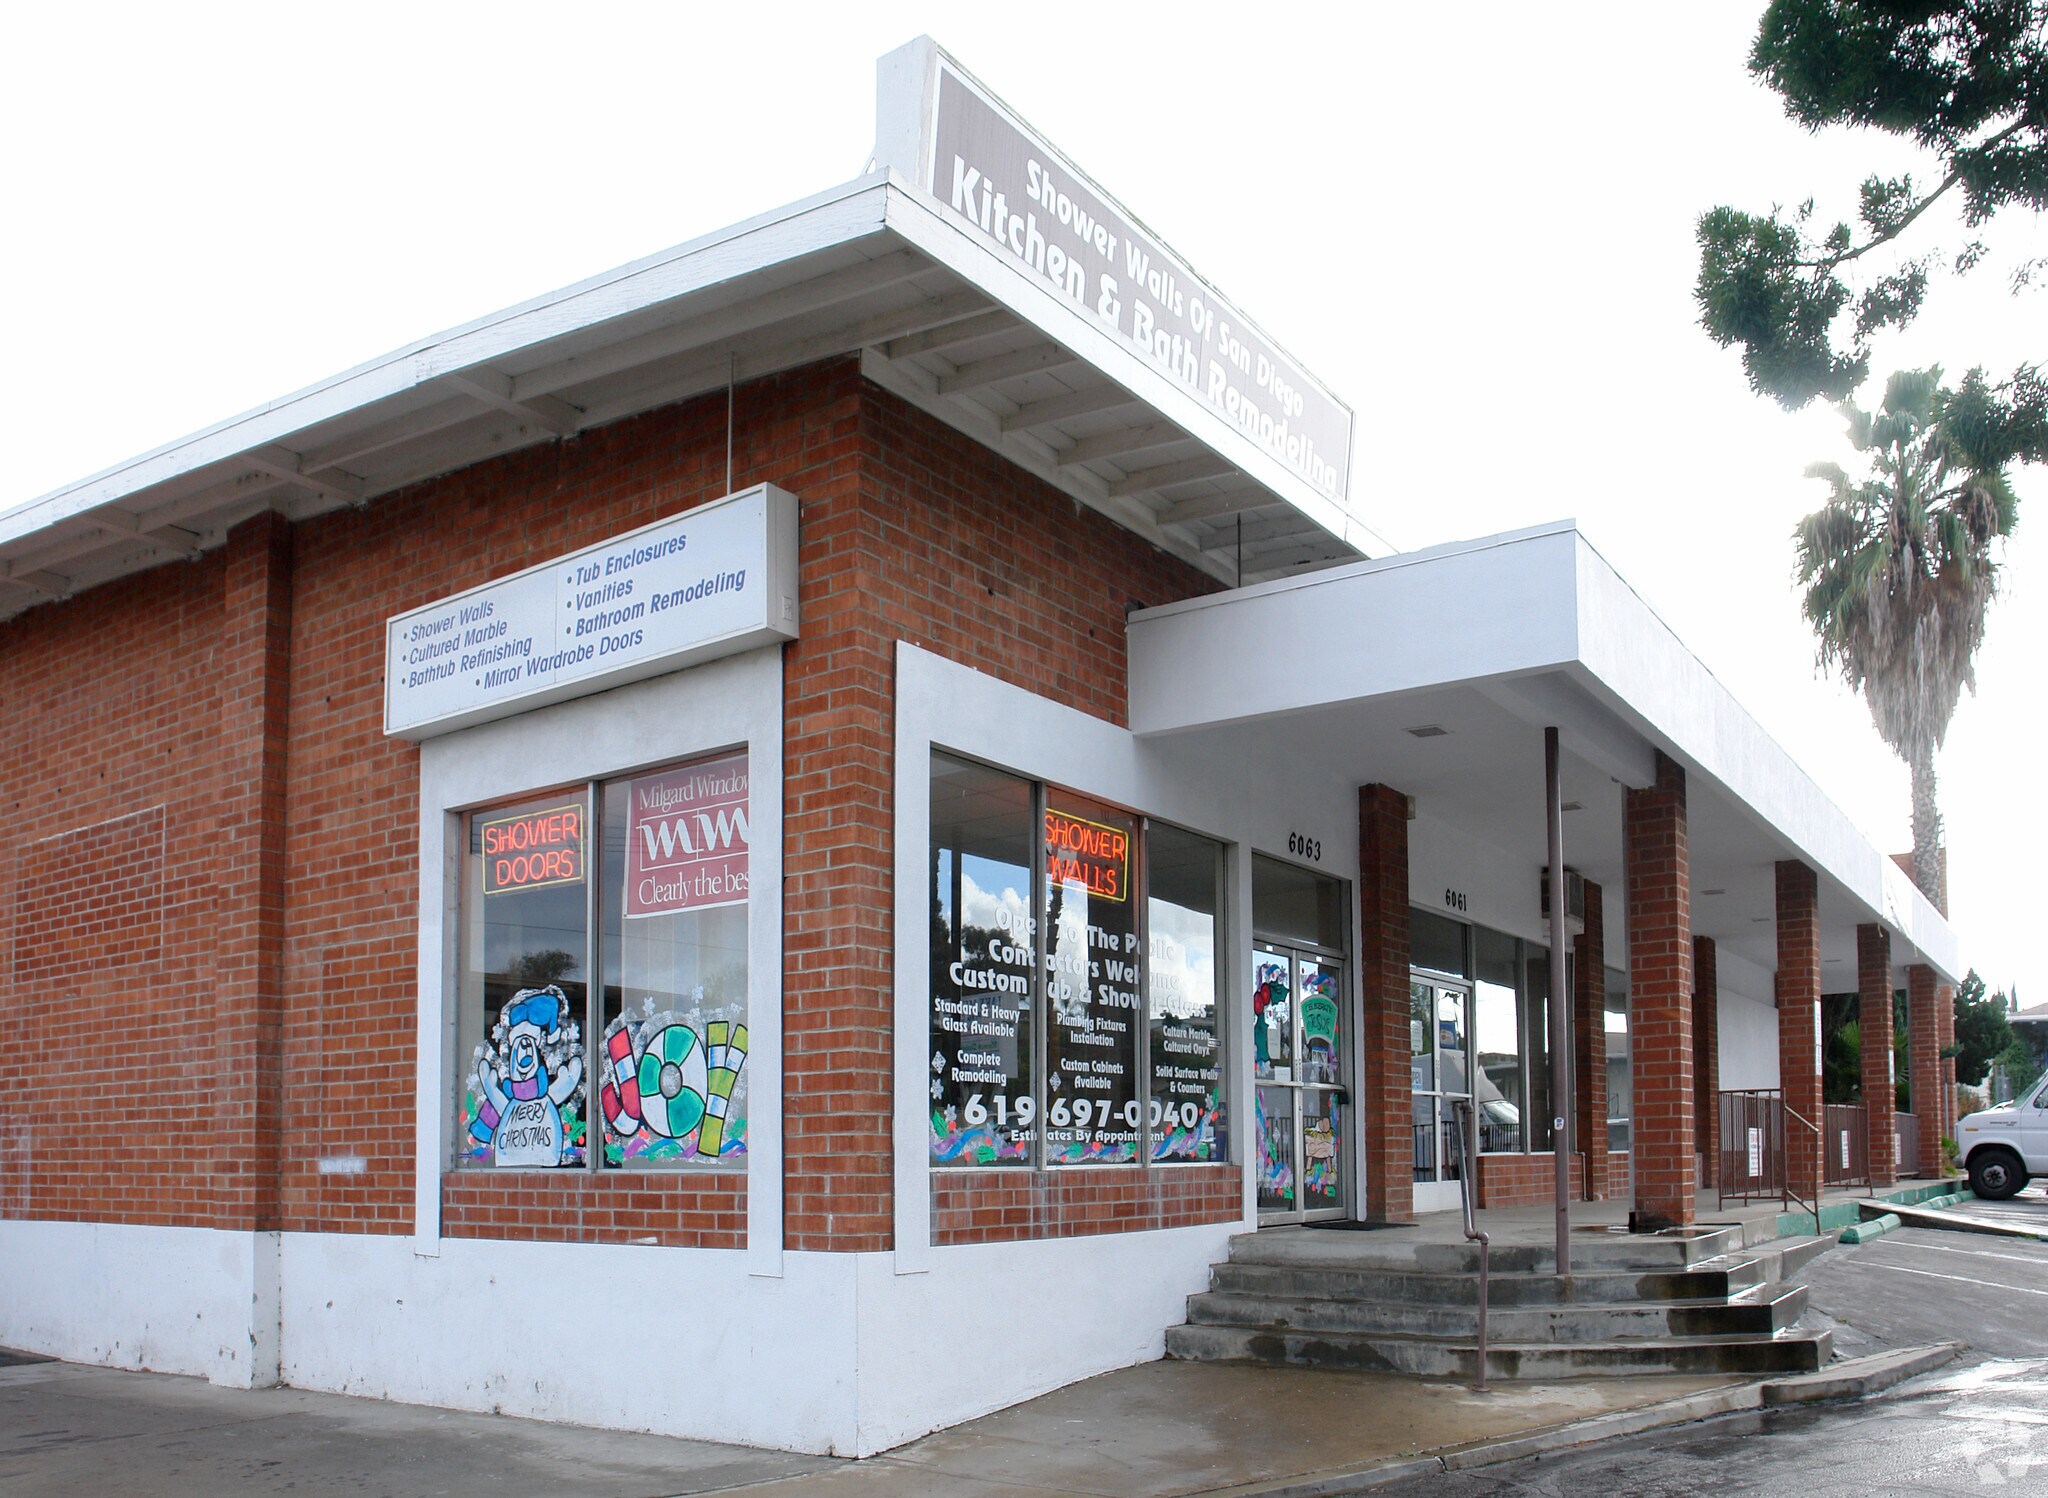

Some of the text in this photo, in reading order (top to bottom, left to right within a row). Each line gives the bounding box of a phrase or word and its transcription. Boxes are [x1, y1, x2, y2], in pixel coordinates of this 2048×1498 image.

[952, 154, 1086, 306] Kitchen
[1098, 273, 1122, 330] &
[1133, 298, 1200, 390] Bath
[1026, 157, 1304, 417] Shower Walls Of San Diego
[576, 533, 687, 586] Tub Enclosures
[575, 577, 633, 611] Vanities
[575, 568, 746, 637] Bathroom Remodeling
[411, 600, 494, 642] Shower Walls
[410, 620, 507, 664] Cultured Marble
[484, 627, 643, 689] Mirror Wardrobe Doors
[409, 637, 532, 688] Bathtub Refinishing
[640, 776, 694, 813] Milgard
[486, 812, 579, 854] SHOWER
[1045, 814, 1125, 862] SHOWER
[1289, 832, 1321, 862] 6063
[496, 849, 574, 886] DOORS
[1051, 855, 1116, 895] WALLS
[639, 871, 691, 906] Clearly
[695, 868, 722, 896] the
[1445, 888, 1467, 912] 6061
[995, 906, 1037, 937] Ope
[1086, 924, 1120, 951] The
[989, 939, 1100, 978] Contactors
[949, 961, 1028, 994] Custom
[1033, 974, 1072, 1000] ub
[1079, 981, 1092, 1003] &
[934, 997, 978, 1016] Standard
[981, 1003, 989, 1017] &
[991, 1005, 1020, 1023] Heavy
[943, 1017, 1014, 1037] Glass Available
[1056, 1012, 1127, 1032] Plumbing Fixtures
[1070, 1030, 1115, 1047] Installation
[1163, 1025, 1211, 1040] Culture Marble
[1164, 1040, 1192, 1054] Cultured
[1193, 1043, 1211, 1057] Onyx
[957, 1050, 1001, 1067] Complete
[1060, 1058, 1124, 1074] Custom Cabinets
[1155, 1065, 1173, 1078] Solid
[1174, 1066, 1199, 1079] Surface
[951, 1067, 1007, 1087] Remodeling
[1074, 1075, 1112, 1089] Available
[1170, 1081, 1205, 1094] & Counters
[505, 1101, 549, 1127] MERRY
[963, 1093, 1198, 1129] 619697-0040
[499, 1126, 552, 1150] CHRISTMAS
[1010, 1129, 1072, 1142] Estiates
[1075, 1130, 1091, 1144] By
